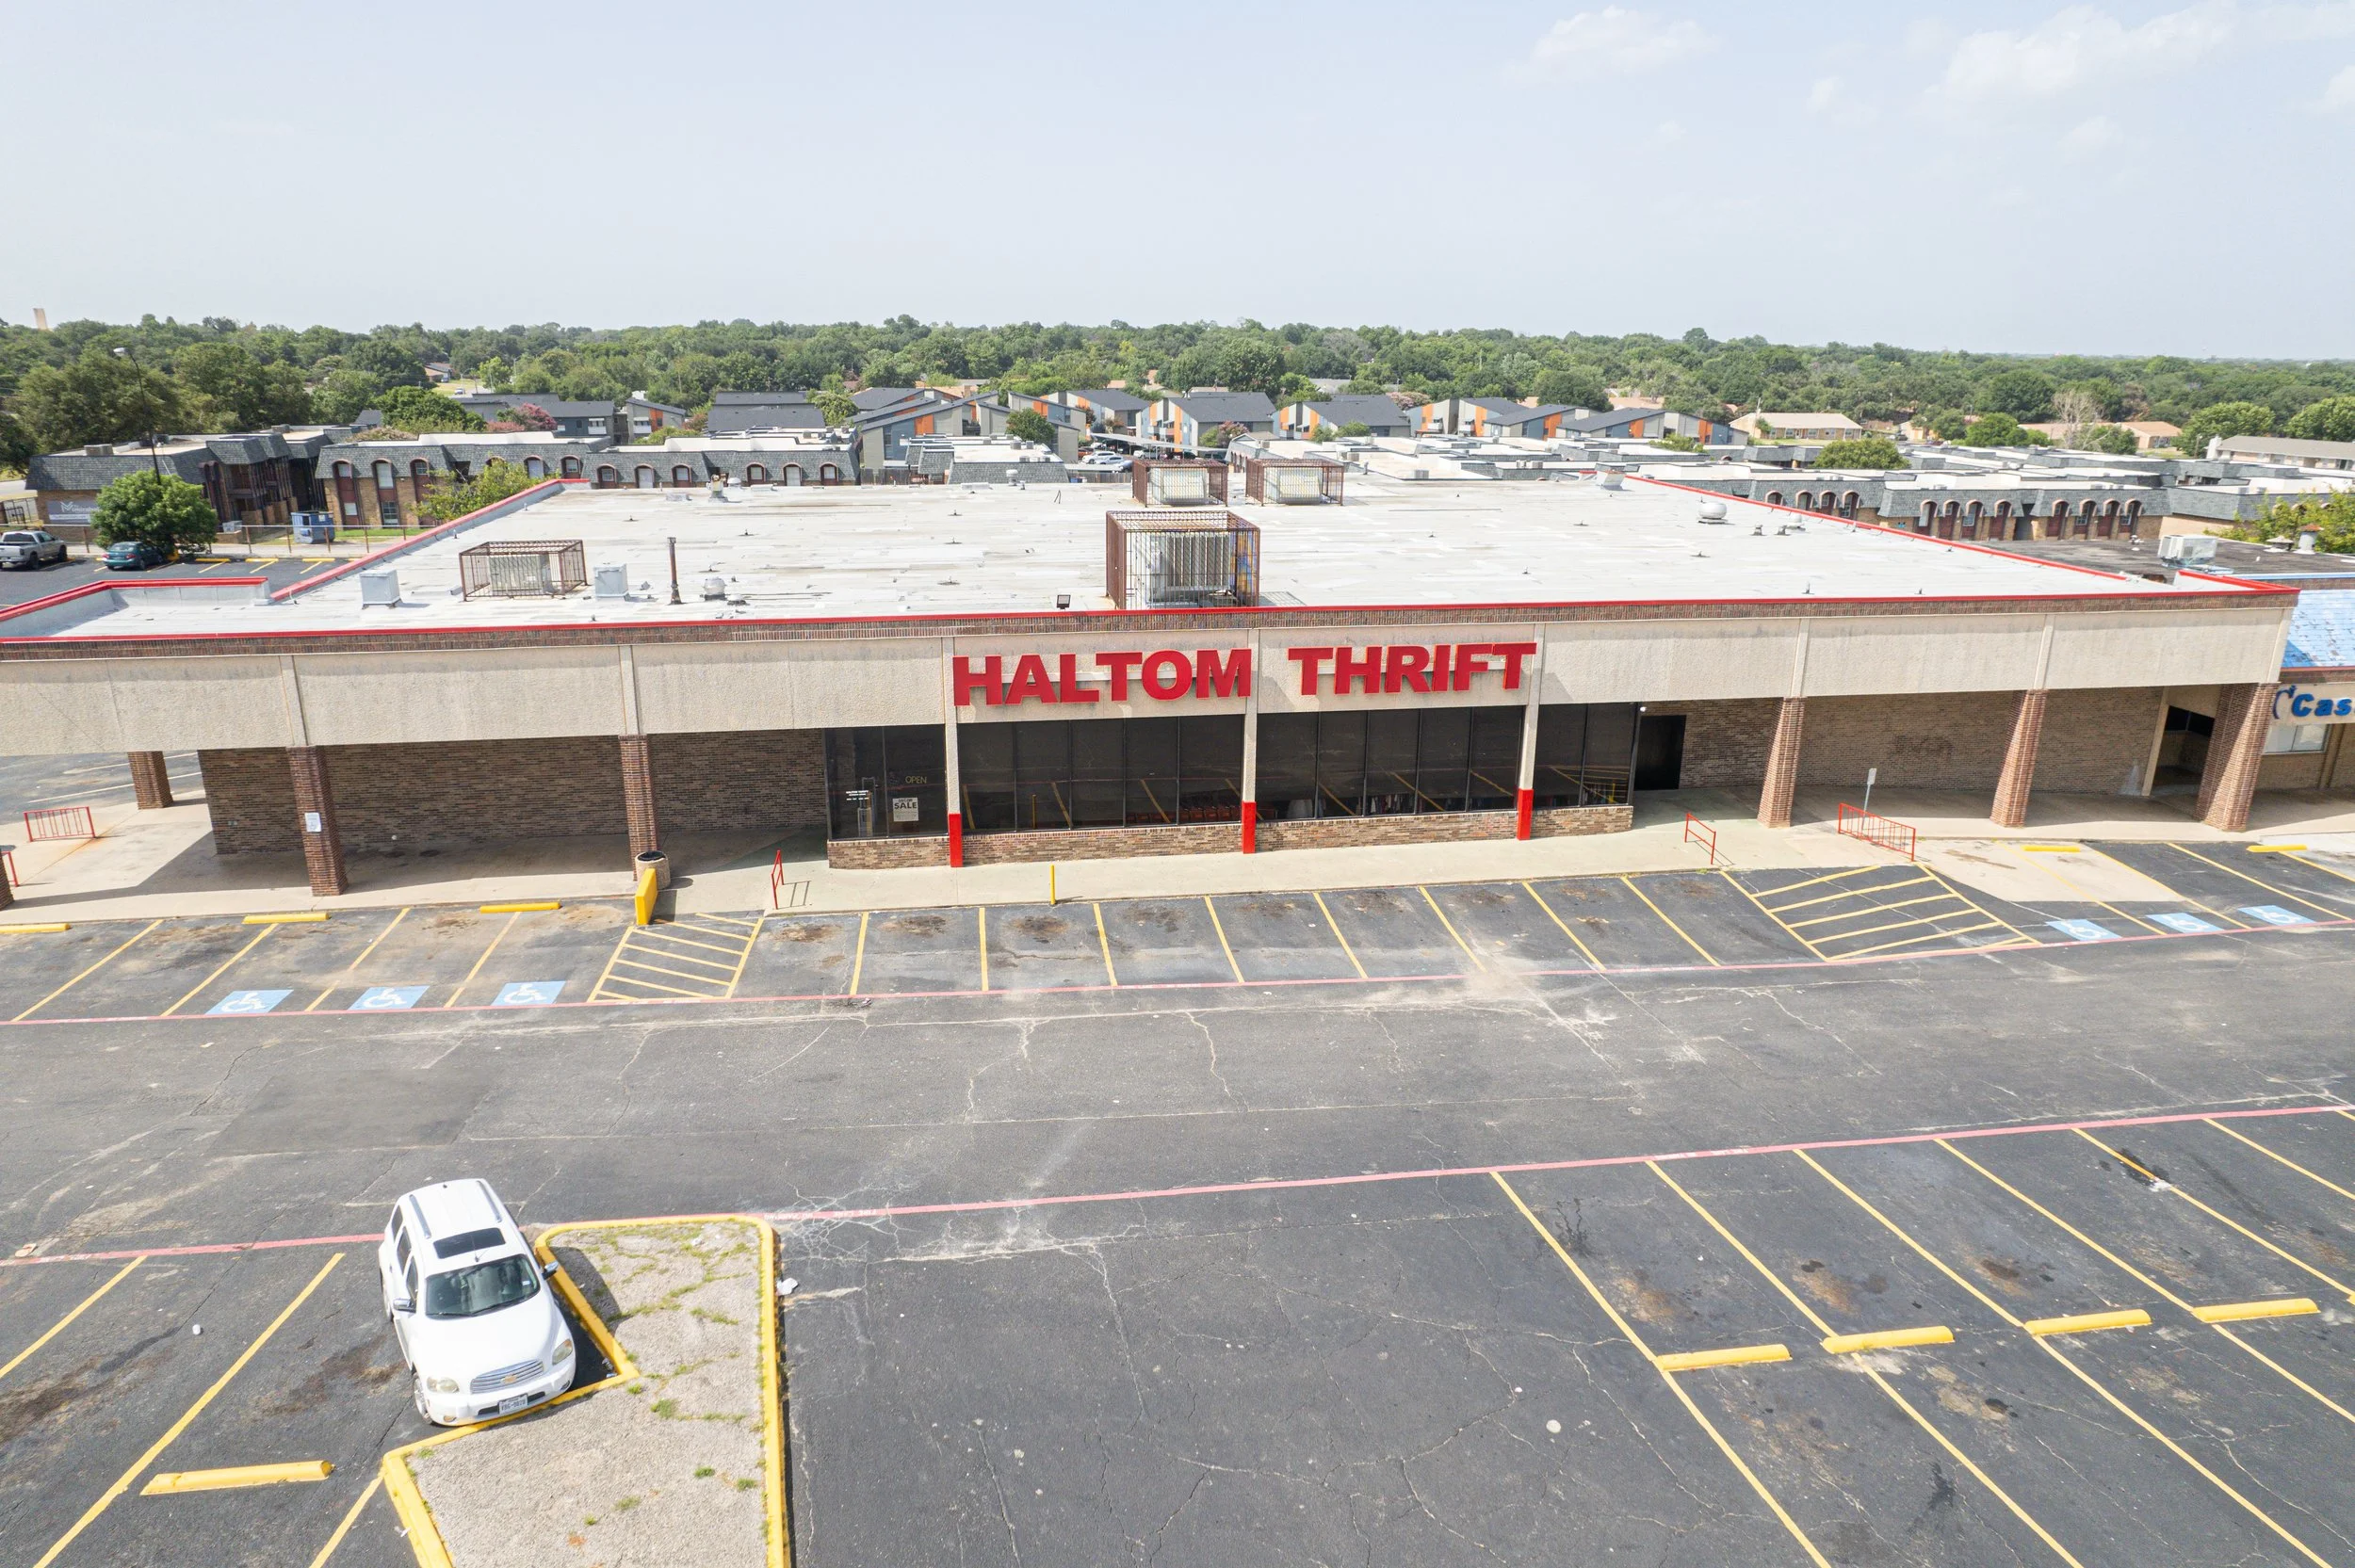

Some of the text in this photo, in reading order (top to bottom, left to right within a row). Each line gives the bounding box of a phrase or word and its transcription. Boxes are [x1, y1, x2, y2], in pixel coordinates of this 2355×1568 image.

[952, 641, 1537, 706] HALTOM THRIFT
[2292, 693, 2355, 717] Cas
[905, 775, 927, 784] OPEN
[894, 801, 918, 810] SALE
